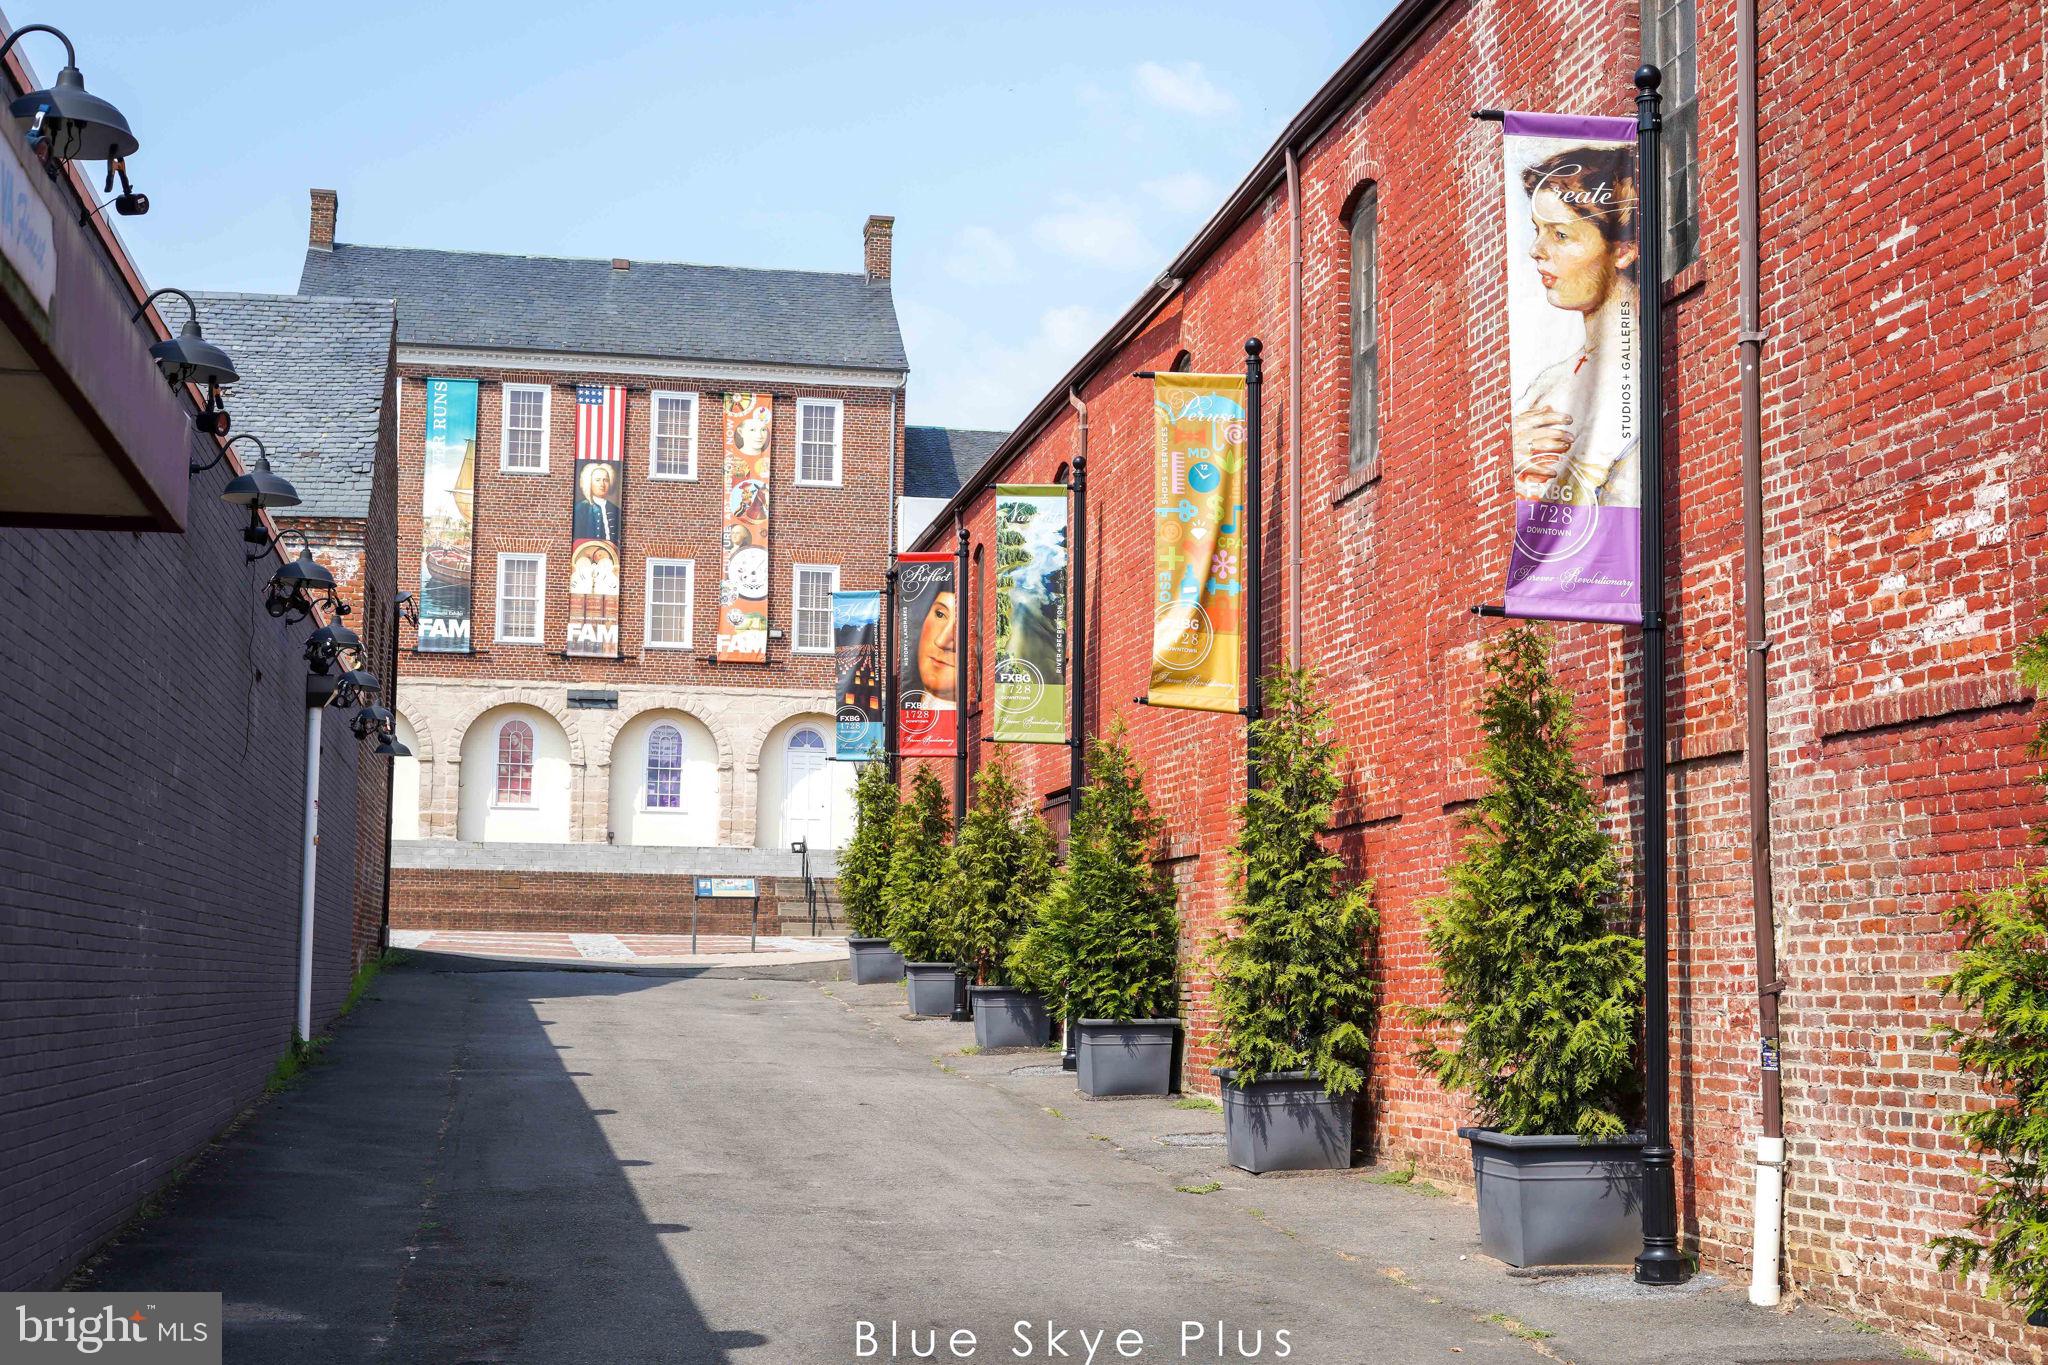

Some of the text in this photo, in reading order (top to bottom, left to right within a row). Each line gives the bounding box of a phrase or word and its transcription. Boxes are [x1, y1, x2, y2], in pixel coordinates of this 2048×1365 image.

[1531, 163, 1638, 223] Create
[1620, 301, 1631, 371] GALLERIES
[433, 381, 448, 430] RUNS
[1621, 383, 1631, 439] STUDIOS
[1161, 426, 1169, 467] SERVICES
[1187, 447, 1211, 459] MD
[1161, 476, 1169, 505] SHOPS
[1527, 503, 1573, 525] 1728
[1526, 525, 1572, 537] DOWNTOWN
[901, 564, 953, 602] Reflect
[1514, 565, 1634, 598] Forever Revolutionary
[418, 618, 471, 638] FAM
[567, 622, 619, 644] FAM
[717, 631, 767, 653] FAM
[1000, 673, 1031, 683] FXBG
[1001, 684, 1031, 694] 1728
[905, 710, 930, 719] 1728
[840, 722, 861, 730] 1728
